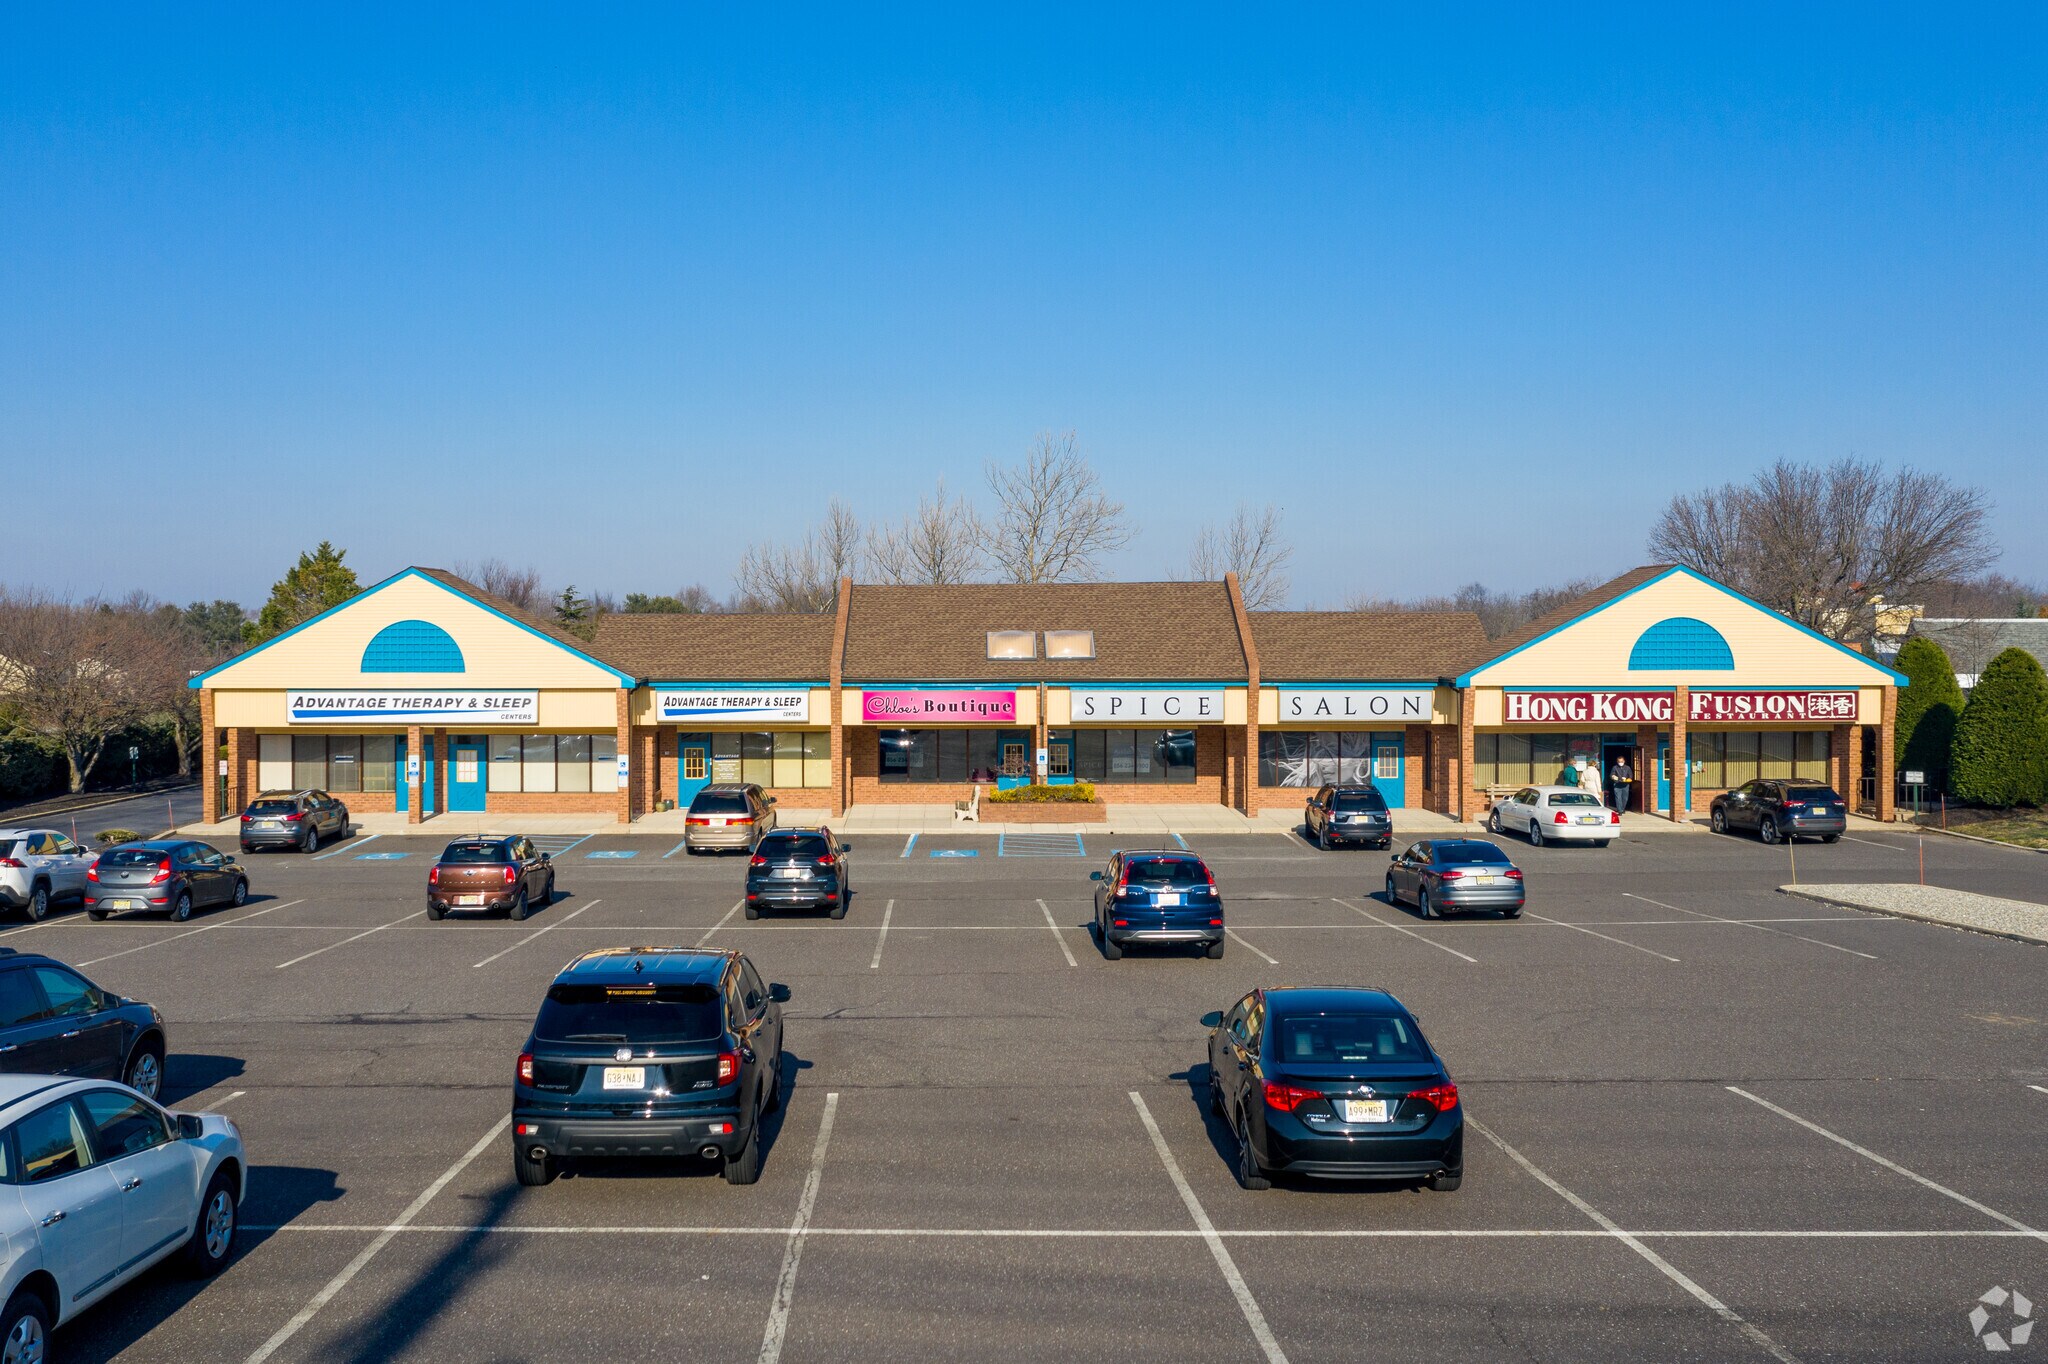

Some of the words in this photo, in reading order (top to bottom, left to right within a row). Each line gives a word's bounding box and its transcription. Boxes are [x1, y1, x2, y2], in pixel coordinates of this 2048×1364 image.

[293, 696, 388, 708] ADVANTAGE
[392, 697, 464, 708] THERAPY
[468, 697, 478, 708] &
[483, 697, 532, 708] SLEEP
[663, 696, 718, 707] ADVANTAGE
[721, 697, 762, 707] THERAPY
[764, 697, 770, 707] &
[773, 697, 802, 707] SLEEP
[867, 696, 920, 714] Chloe's
[923, 699, 1012, 716] Boutique
[1084, 696, 1211, 716] SPICE
[1291, 696, 1421, 716] SALON
[1506, 694, 1588, 721] HONG
[1591, 694, 1673, 721] KONG
[1690, 693, 1807, 714] FUSION
